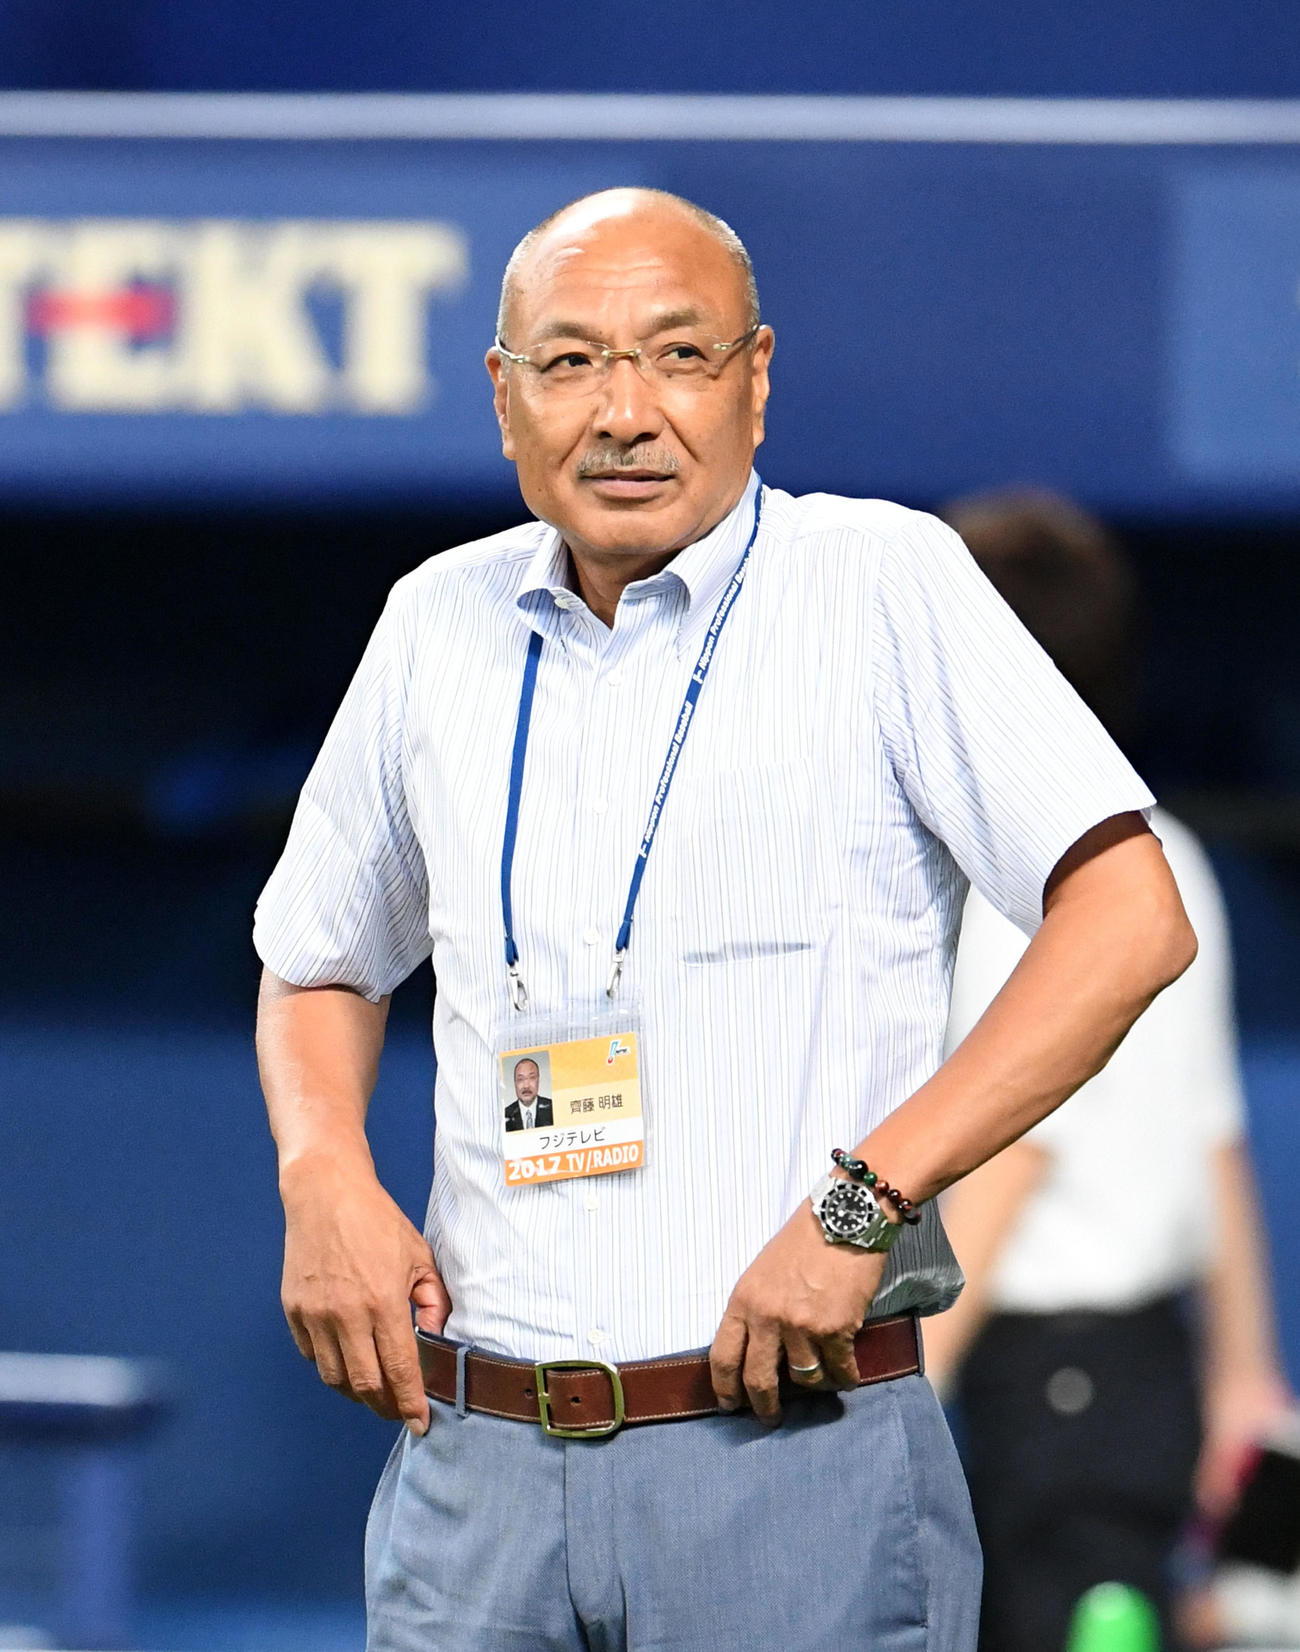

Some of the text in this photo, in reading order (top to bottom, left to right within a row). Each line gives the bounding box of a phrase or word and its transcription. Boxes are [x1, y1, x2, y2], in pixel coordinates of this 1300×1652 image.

[698, 634, 716, 670] Nippon
[710, 579, 739, 636] Professional
[644, 700, 694, 842] Nippon Professional Baseball
[508, 1144, 640, 1181] 2017 TV/RADIO
[539, 1127, 606, 1150] フジテレビ
